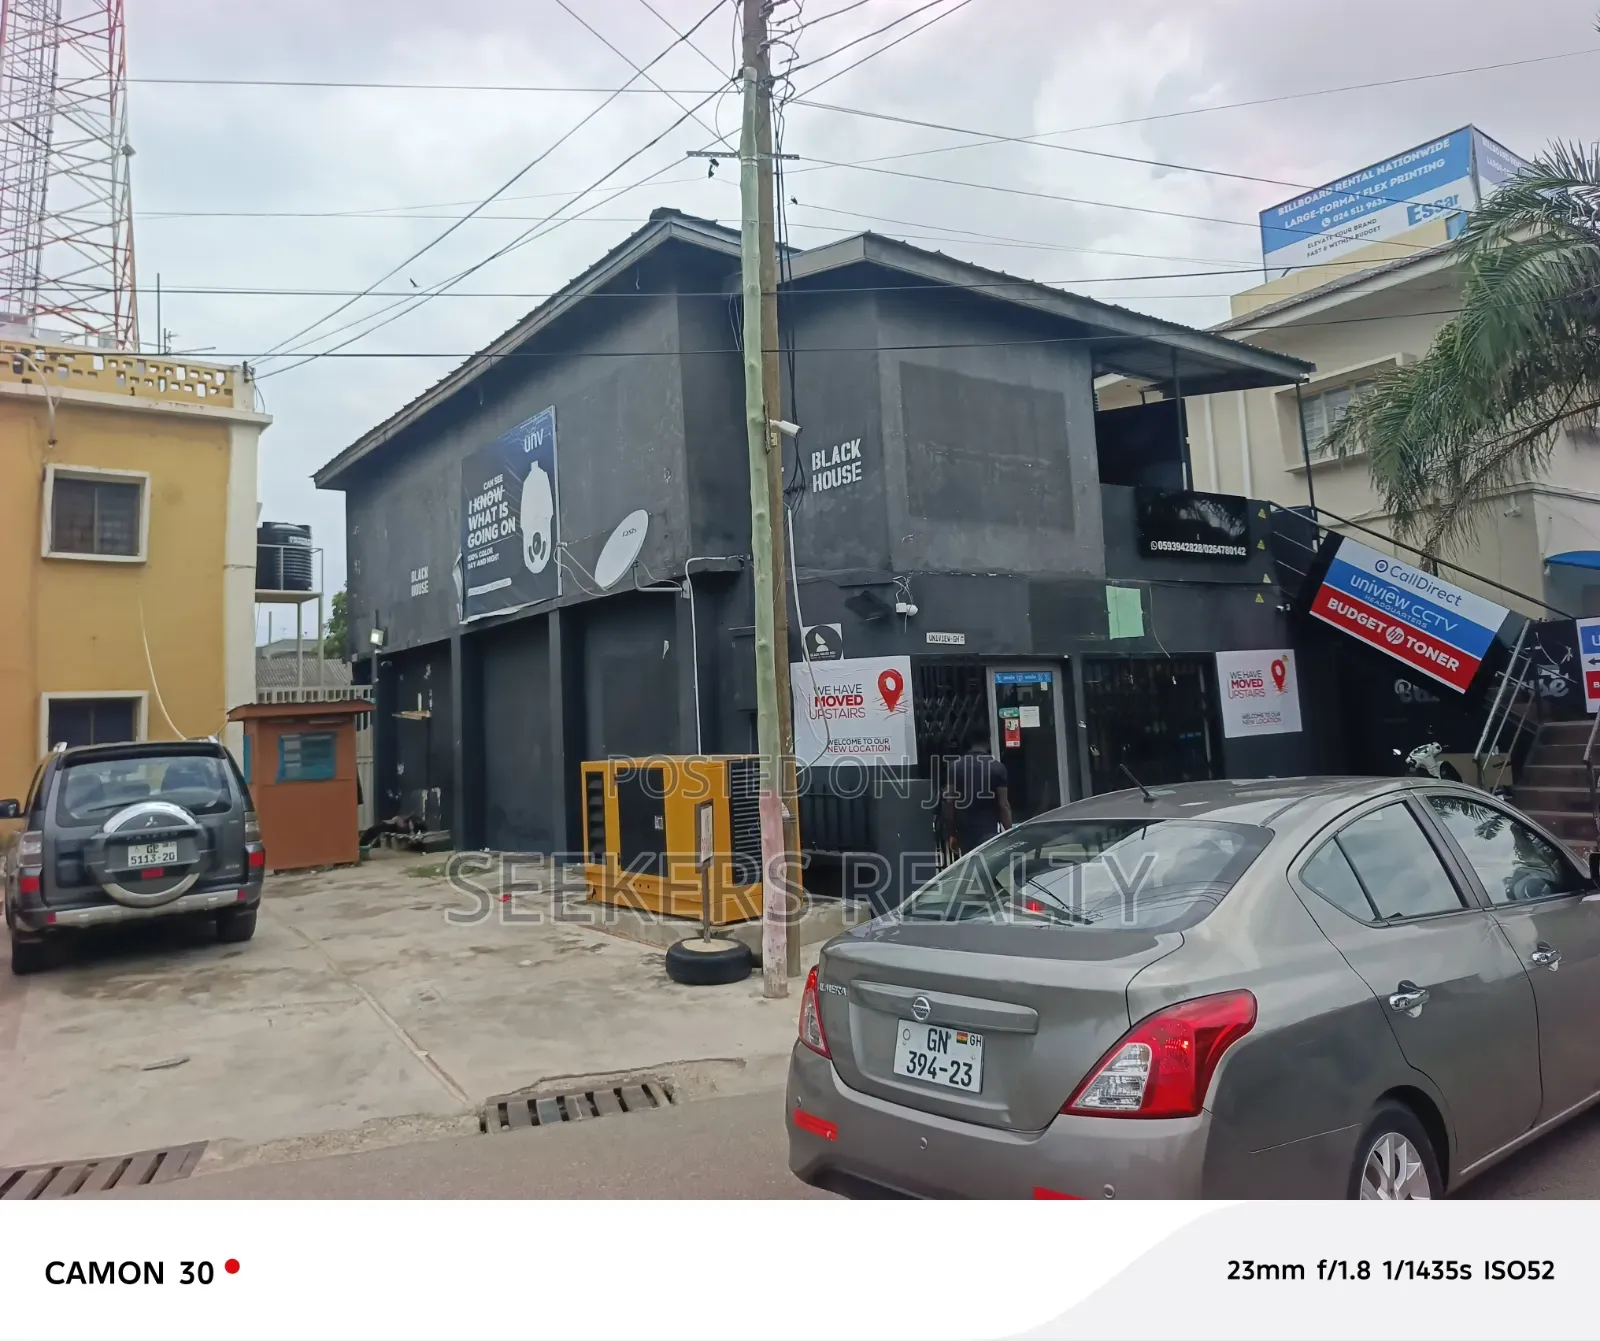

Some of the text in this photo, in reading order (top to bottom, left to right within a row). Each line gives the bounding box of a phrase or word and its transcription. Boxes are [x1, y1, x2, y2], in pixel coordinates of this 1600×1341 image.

[1278, 138, 1450, 216] BILLBOARD RENTAL NATIONWIDE
[1285, 158, 1446, 228] LARGE-FORMAT FLEX PRINTING
[1333, 210, 1349, 222] 024
[1350, 204, 1364, 216] 511
[1307, 218, 1377, 249] ELEVATE YOUR BRAND
[1307, 248, 1322, 258] FAST
[1329, 235, 1353, 249] WITHIN
[1355, 225, 1381, 239] BUDGET
[811, 438, 861, 472] BLACK
[483, 473, 504, 490] CAN SEE
[812, 461, 862, 493] HOUSE
[473, 485, 504, 513] KNOW
[468, 501, 509, 531] WHAT IS
[467, 516, 516, 548] GOING ON
[476, 557, 487, 567] AND
[478, 547, 494, 558] COLOR
[1390, 565, 1463, 607] CallDirect
[1350, 574, 1459, 632] uniview CCTV
[1364, 594, 1428, 629] HEADQUARTERS
[1327, 598, 1388, 633] BUDGET
[1407, 635, 1460, 672] TONER
[1229, 670, 1262, 679] WE HAVE
[1231, 679, 1264, 689] MOVED
[814, 684, 862, 696] WE HAVE
[815, 695, 864, 708] MOVED
[1227, 684, 1266, 699] UPSTAIRS
[809, 702, 866, 720] UPSTAIRS
[827, 744, 891, 753] NEW LOCATION
[130, 852, 175, 865] 5113-20
[926, 1028, 982, 1055] GN GH
[906, 1050, 973, 1087] 394-23
